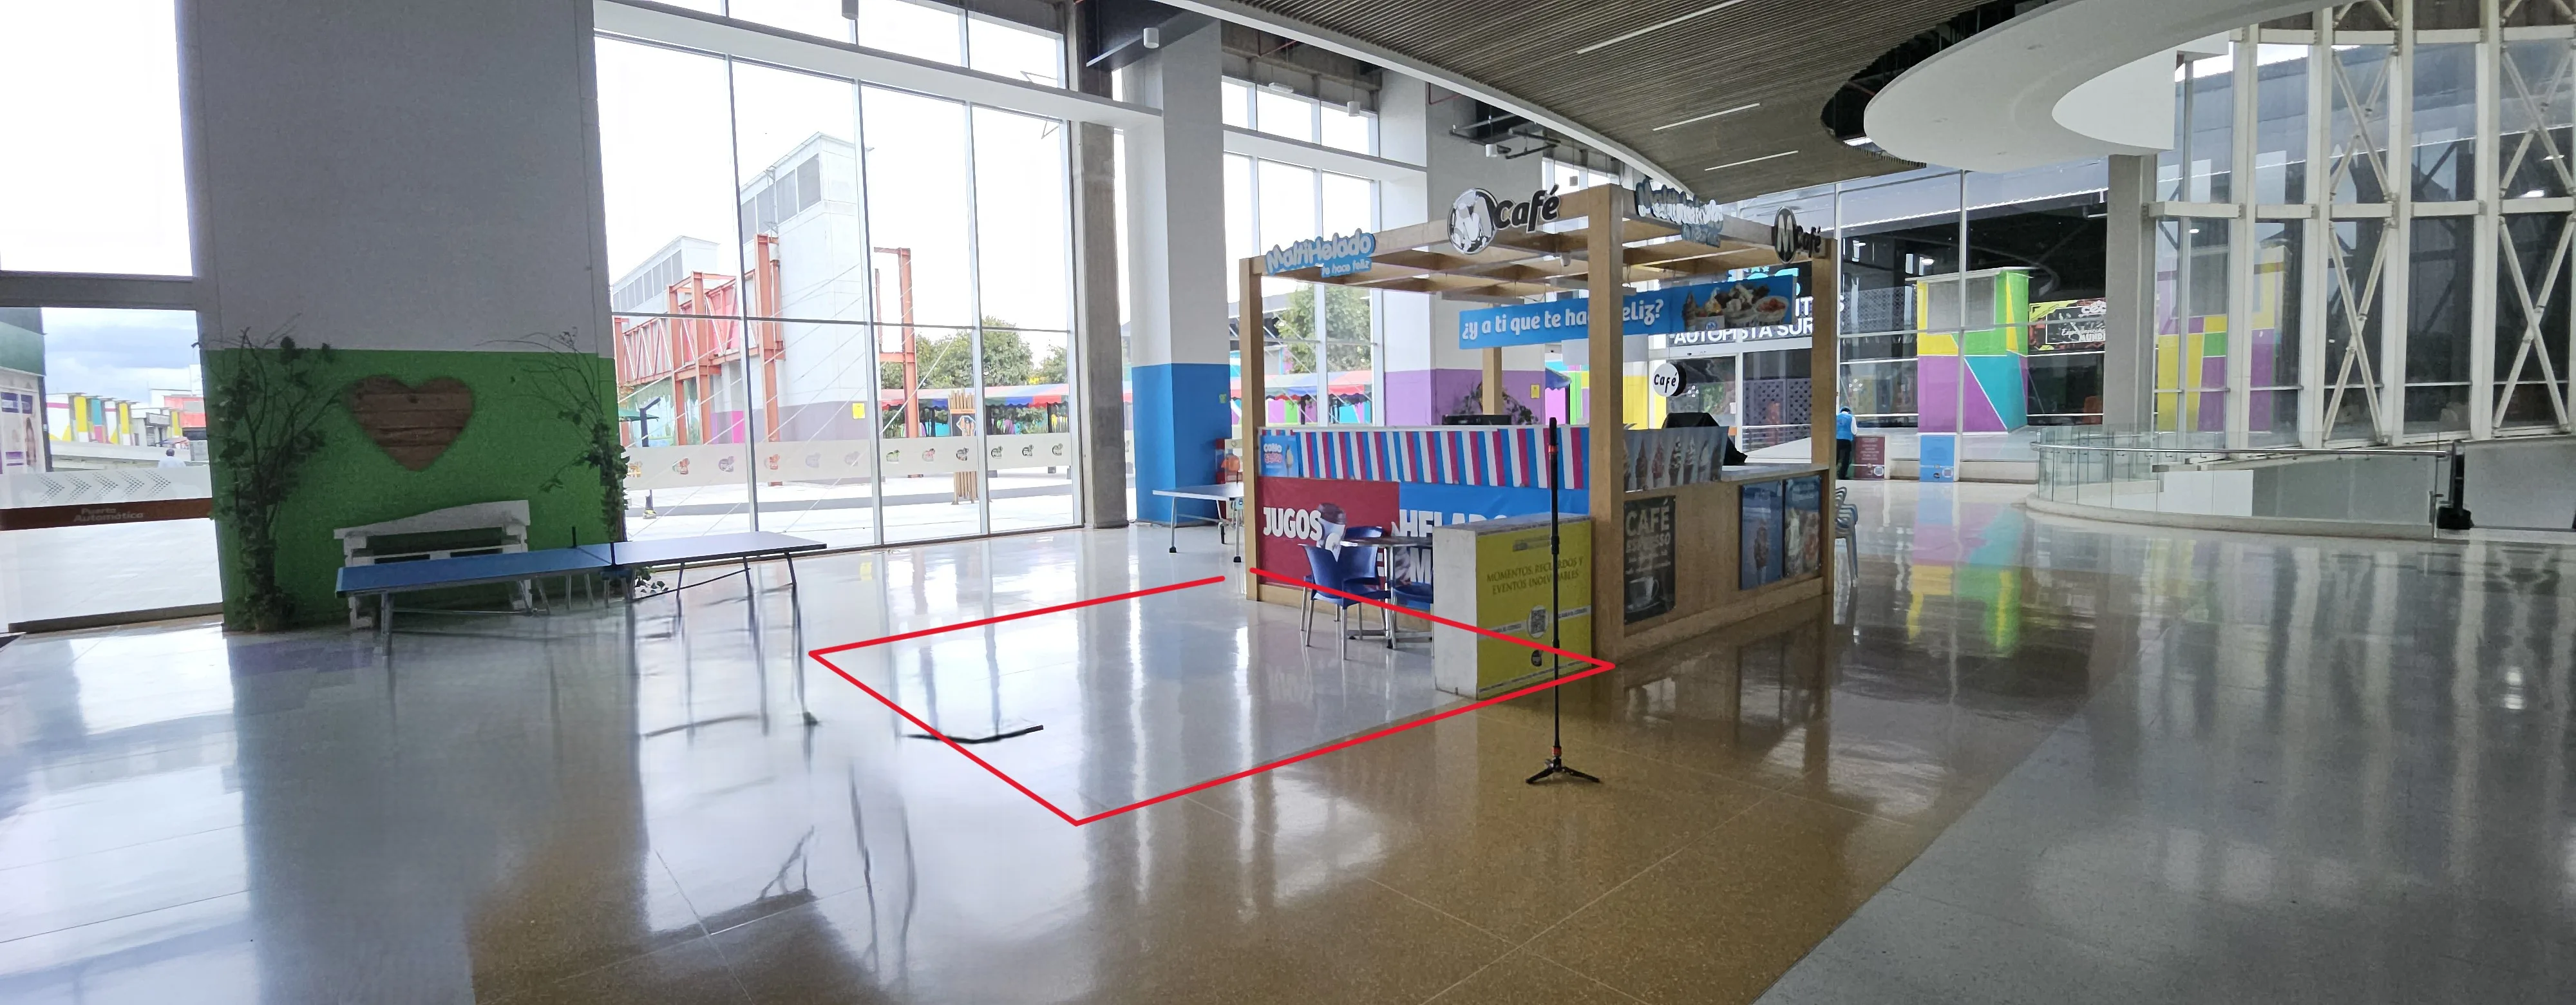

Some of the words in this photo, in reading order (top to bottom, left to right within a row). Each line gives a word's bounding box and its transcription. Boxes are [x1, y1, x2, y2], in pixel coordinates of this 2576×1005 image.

[1463, 321, 1478, 340] ¿y
[1482, 320, 1491, 334] a
[1495, 314, 1507, 333] ti
[1544, 311, 1562, 329] te
[1565, 308, 1589, 327] ha
[1623, 299, 1664, 325] eliz?
[1654, 372, 1677, 394] Café
[1263, 507, 1323, 541] JUGOS
[1625, 498, 1670, 537] CAFÉ
[1535, 557, 1578, 573] RECURDOS
[1492, 580, 1528, 595] EVENTOS
[1528, 570, 1580, 587] INOLVABLES
